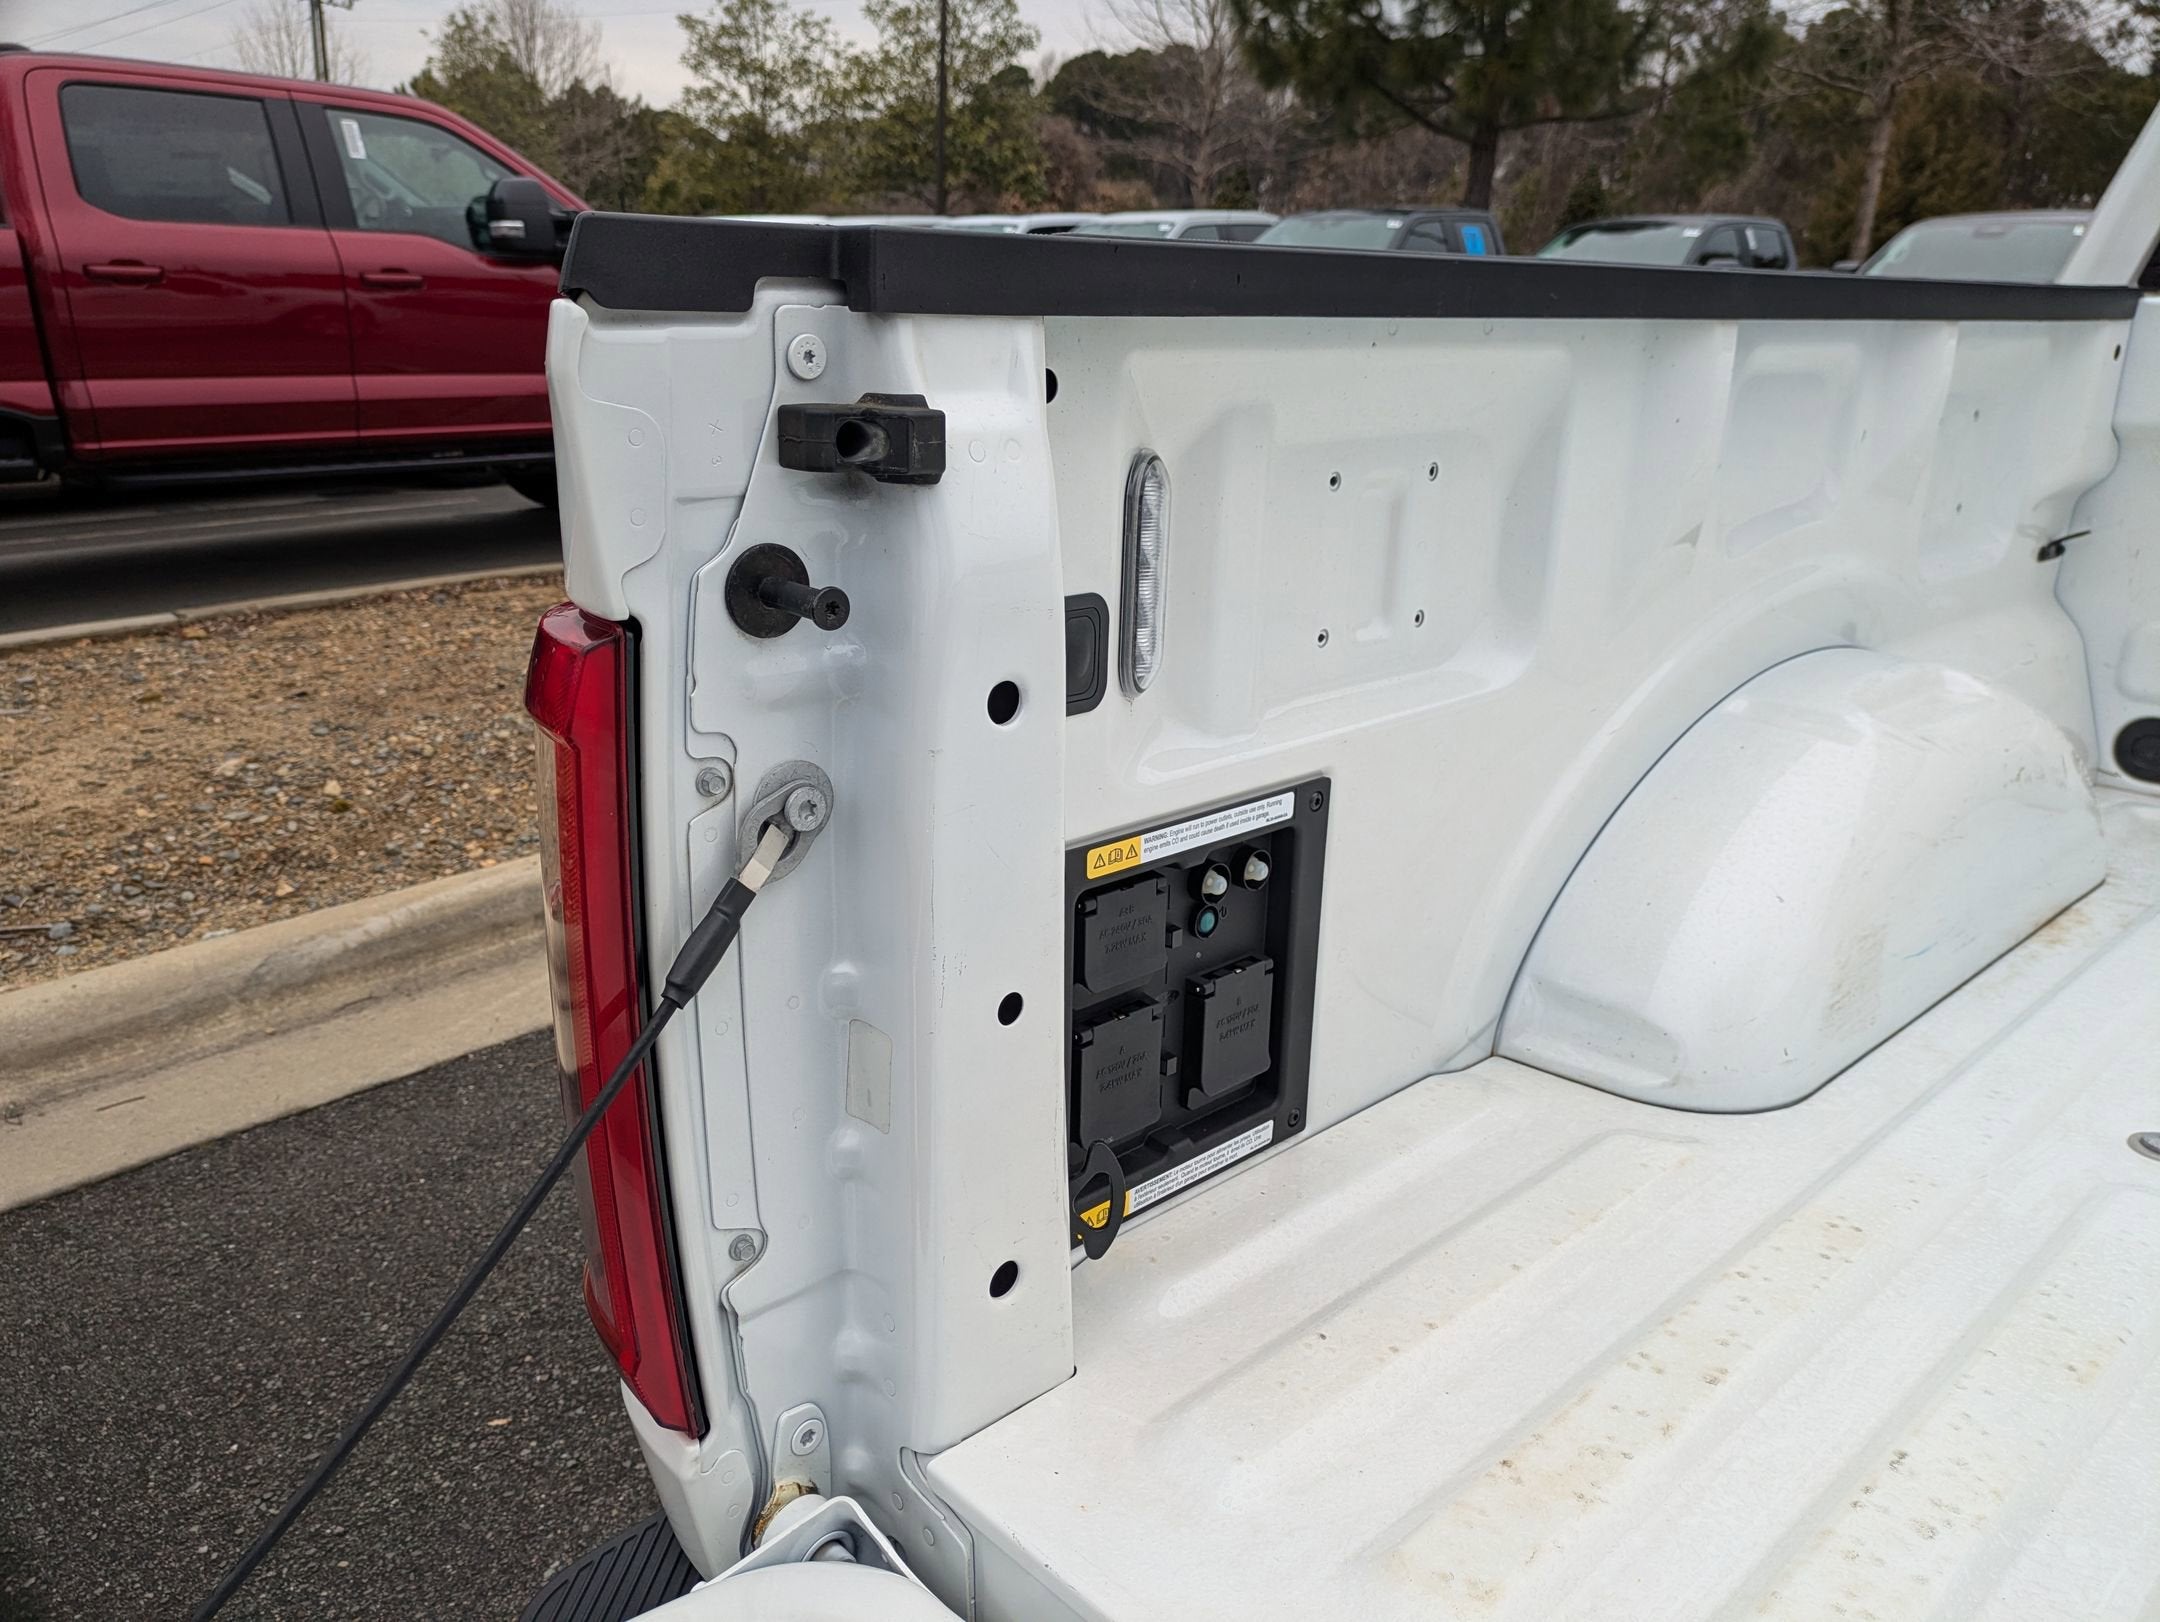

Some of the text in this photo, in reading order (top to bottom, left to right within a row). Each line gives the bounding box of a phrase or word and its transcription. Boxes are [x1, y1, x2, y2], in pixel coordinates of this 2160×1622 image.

[1144, 832, 1169, 845] WARNING:
[1170, 827, 1184, 838] Engine
[1206, 819, 1217, 828] power
[1267, 799, 1282, 810] Running
[1144, 845, 1158, 855] engine
[1160, 841, 1171, 849] emits
[1188, 832, 1200, 840] could
[1201, 828, 1213, 837] cause
[1214, 824, 1225, 833] death
[1230, 820, 1239, 828] used
[1240, 816, 1251, 825] inside
